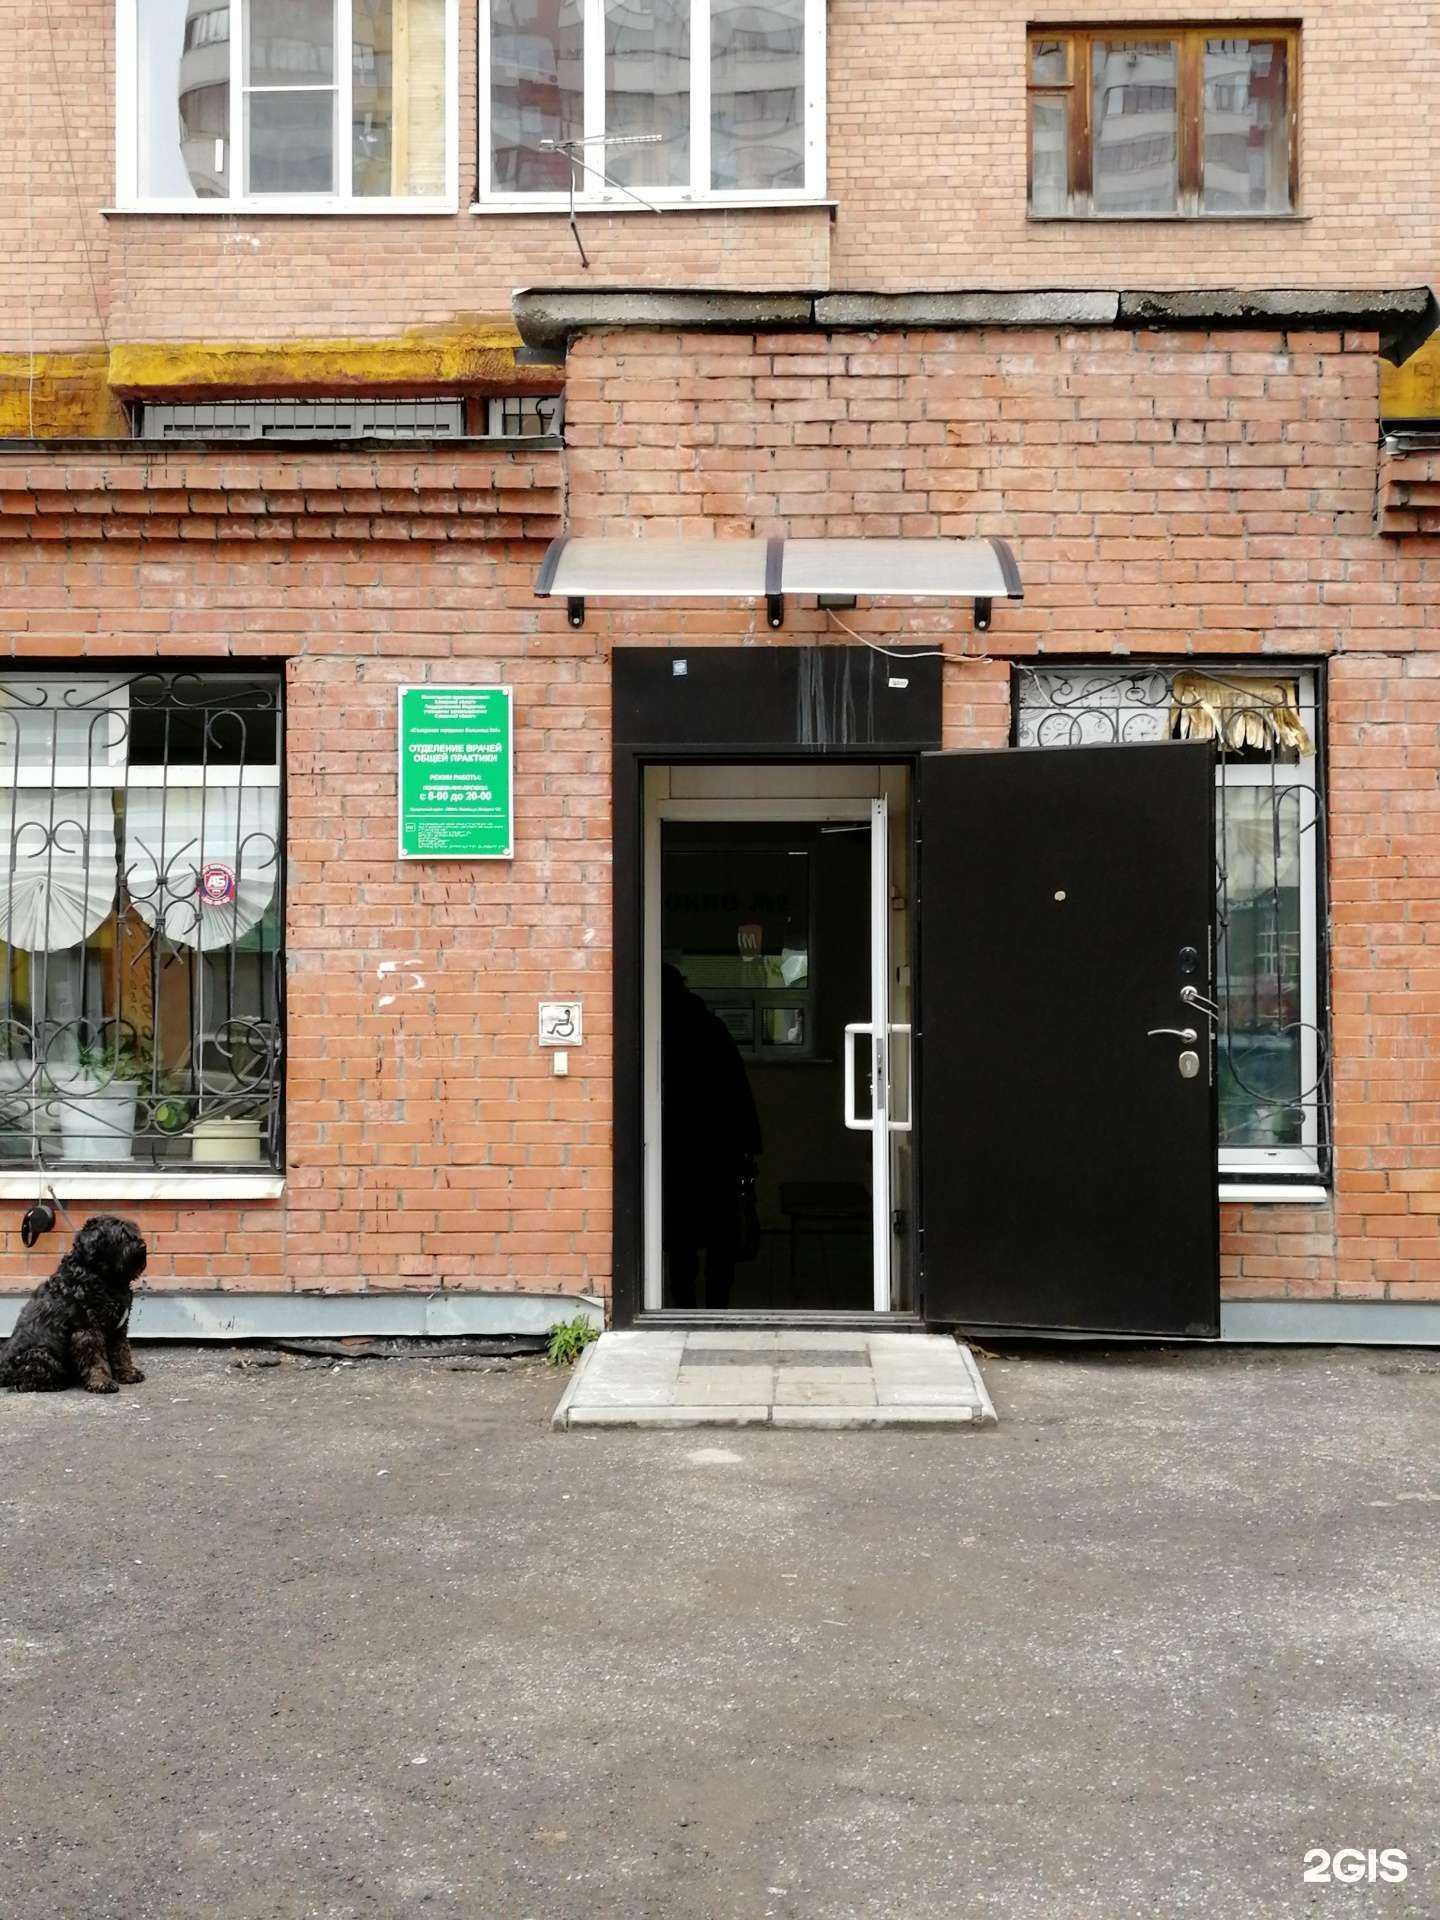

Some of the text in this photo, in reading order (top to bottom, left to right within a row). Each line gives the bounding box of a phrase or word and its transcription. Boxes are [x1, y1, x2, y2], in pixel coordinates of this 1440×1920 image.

[408, 742, 502, 753] ОТДЕЛЕНИЕ ВРАЧЕЙ
[413, 752, 498, 763] ОБЩЕЙ ПРАКТИКИ
[450, 793, 464, 803] до
[465, 791, 492, 801] 20-00
